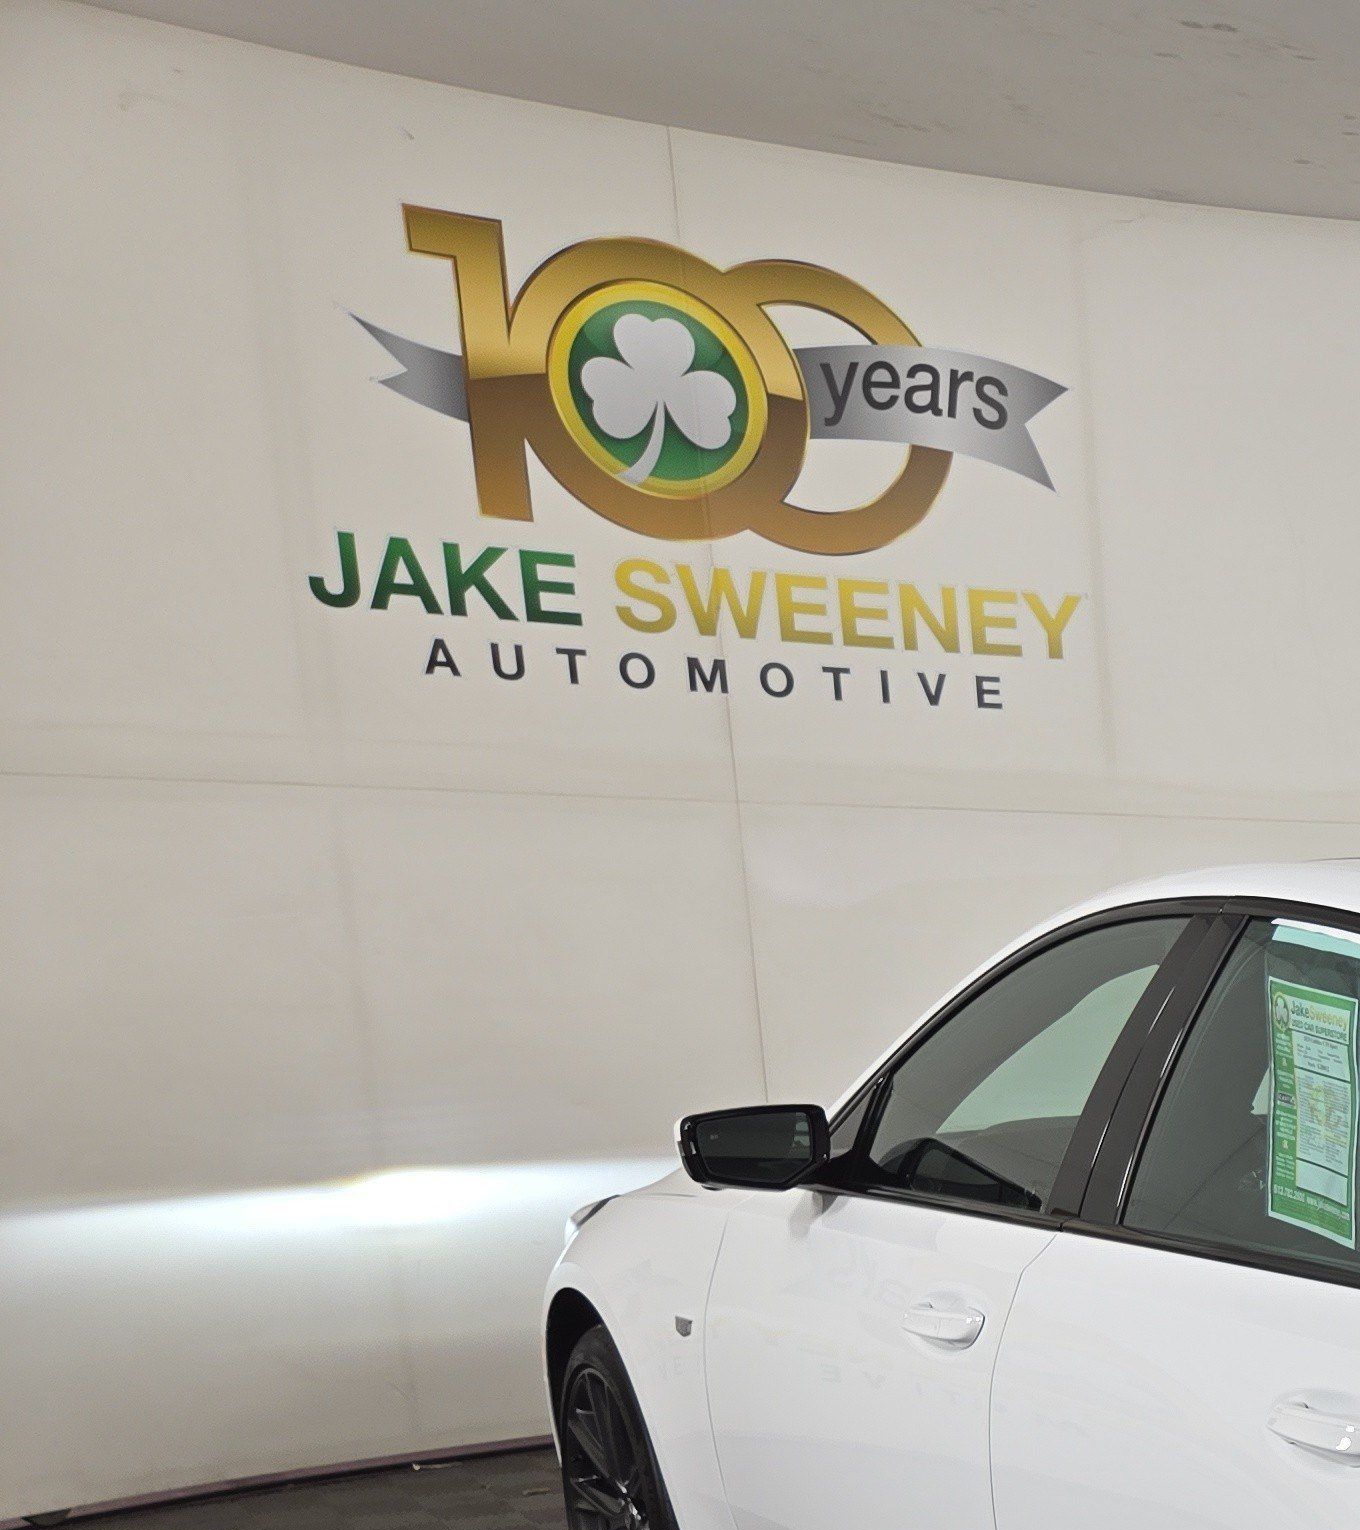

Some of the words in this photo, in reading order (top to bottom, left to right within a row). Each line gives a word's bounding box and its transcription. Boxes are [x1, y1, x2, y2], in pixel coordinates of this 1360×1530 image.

[402, 203, 954, 556] 100
[819, 355, 1010, 431] years
[308, 530, 584, 627] JAKE
[614, 558, 1082, 660] SWEENEY
[423, 637, 1004, 710] AUTOMOTIVE
